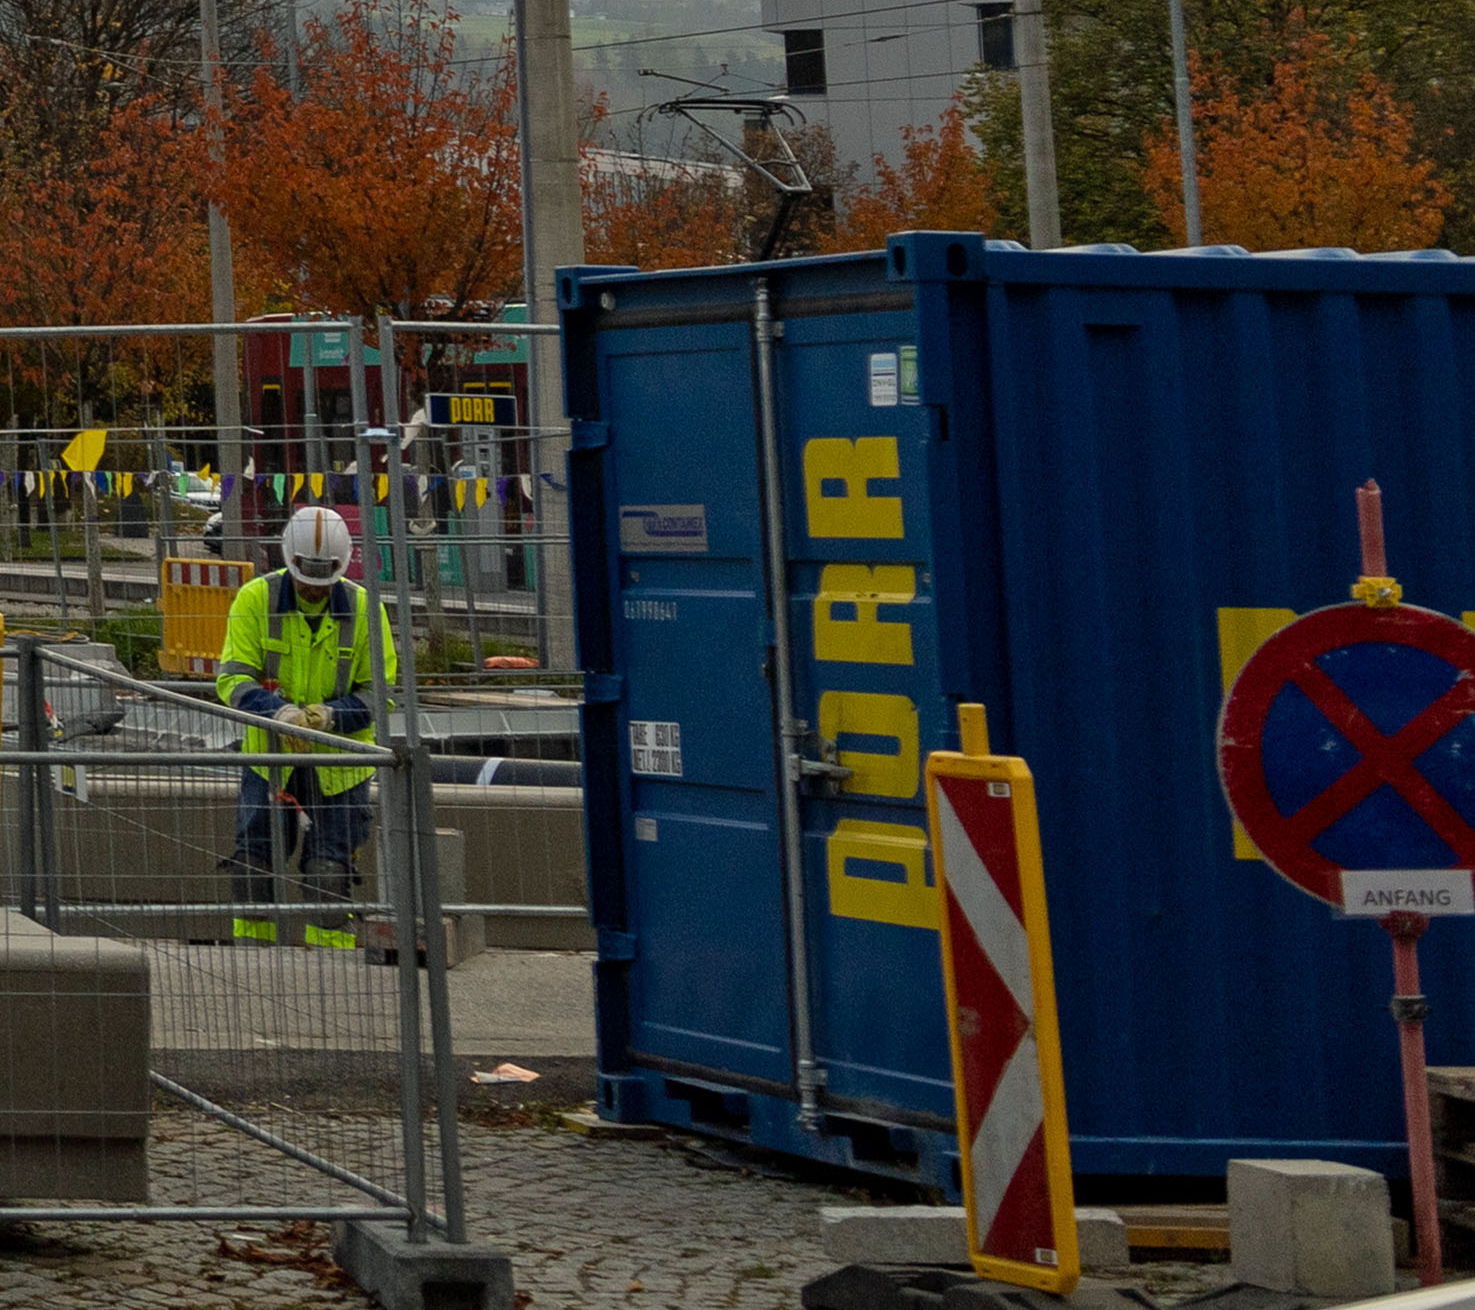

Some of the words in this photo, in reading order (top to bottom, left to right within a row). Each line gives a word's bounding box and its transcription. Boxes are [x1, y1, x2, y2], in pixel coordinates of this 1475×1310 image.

[450, 396, 495, 424] PORR
[803, 436, 941, 931] PORR
[1363, 889, 1452, 906] ANFANG
